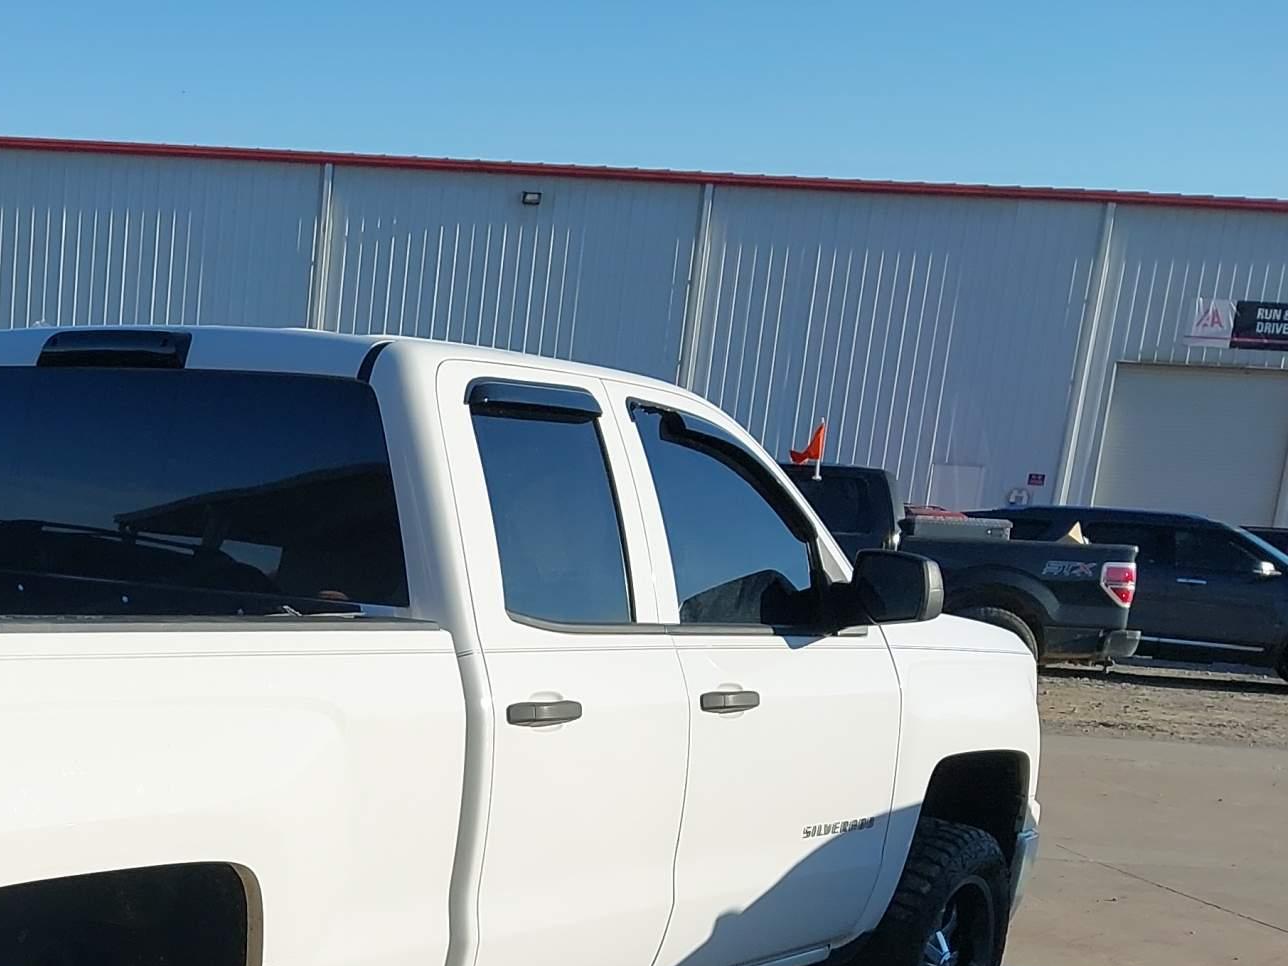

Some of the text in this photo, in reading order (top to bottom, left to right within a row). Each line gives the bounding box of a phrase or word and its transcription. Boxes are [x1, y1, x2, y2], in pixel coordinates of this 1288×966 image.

[1256, 307, 1282, 321] RUN
[1256, 321, 1288, 335] DRIVE
[802, 816, 875, 839] SILVERADO
